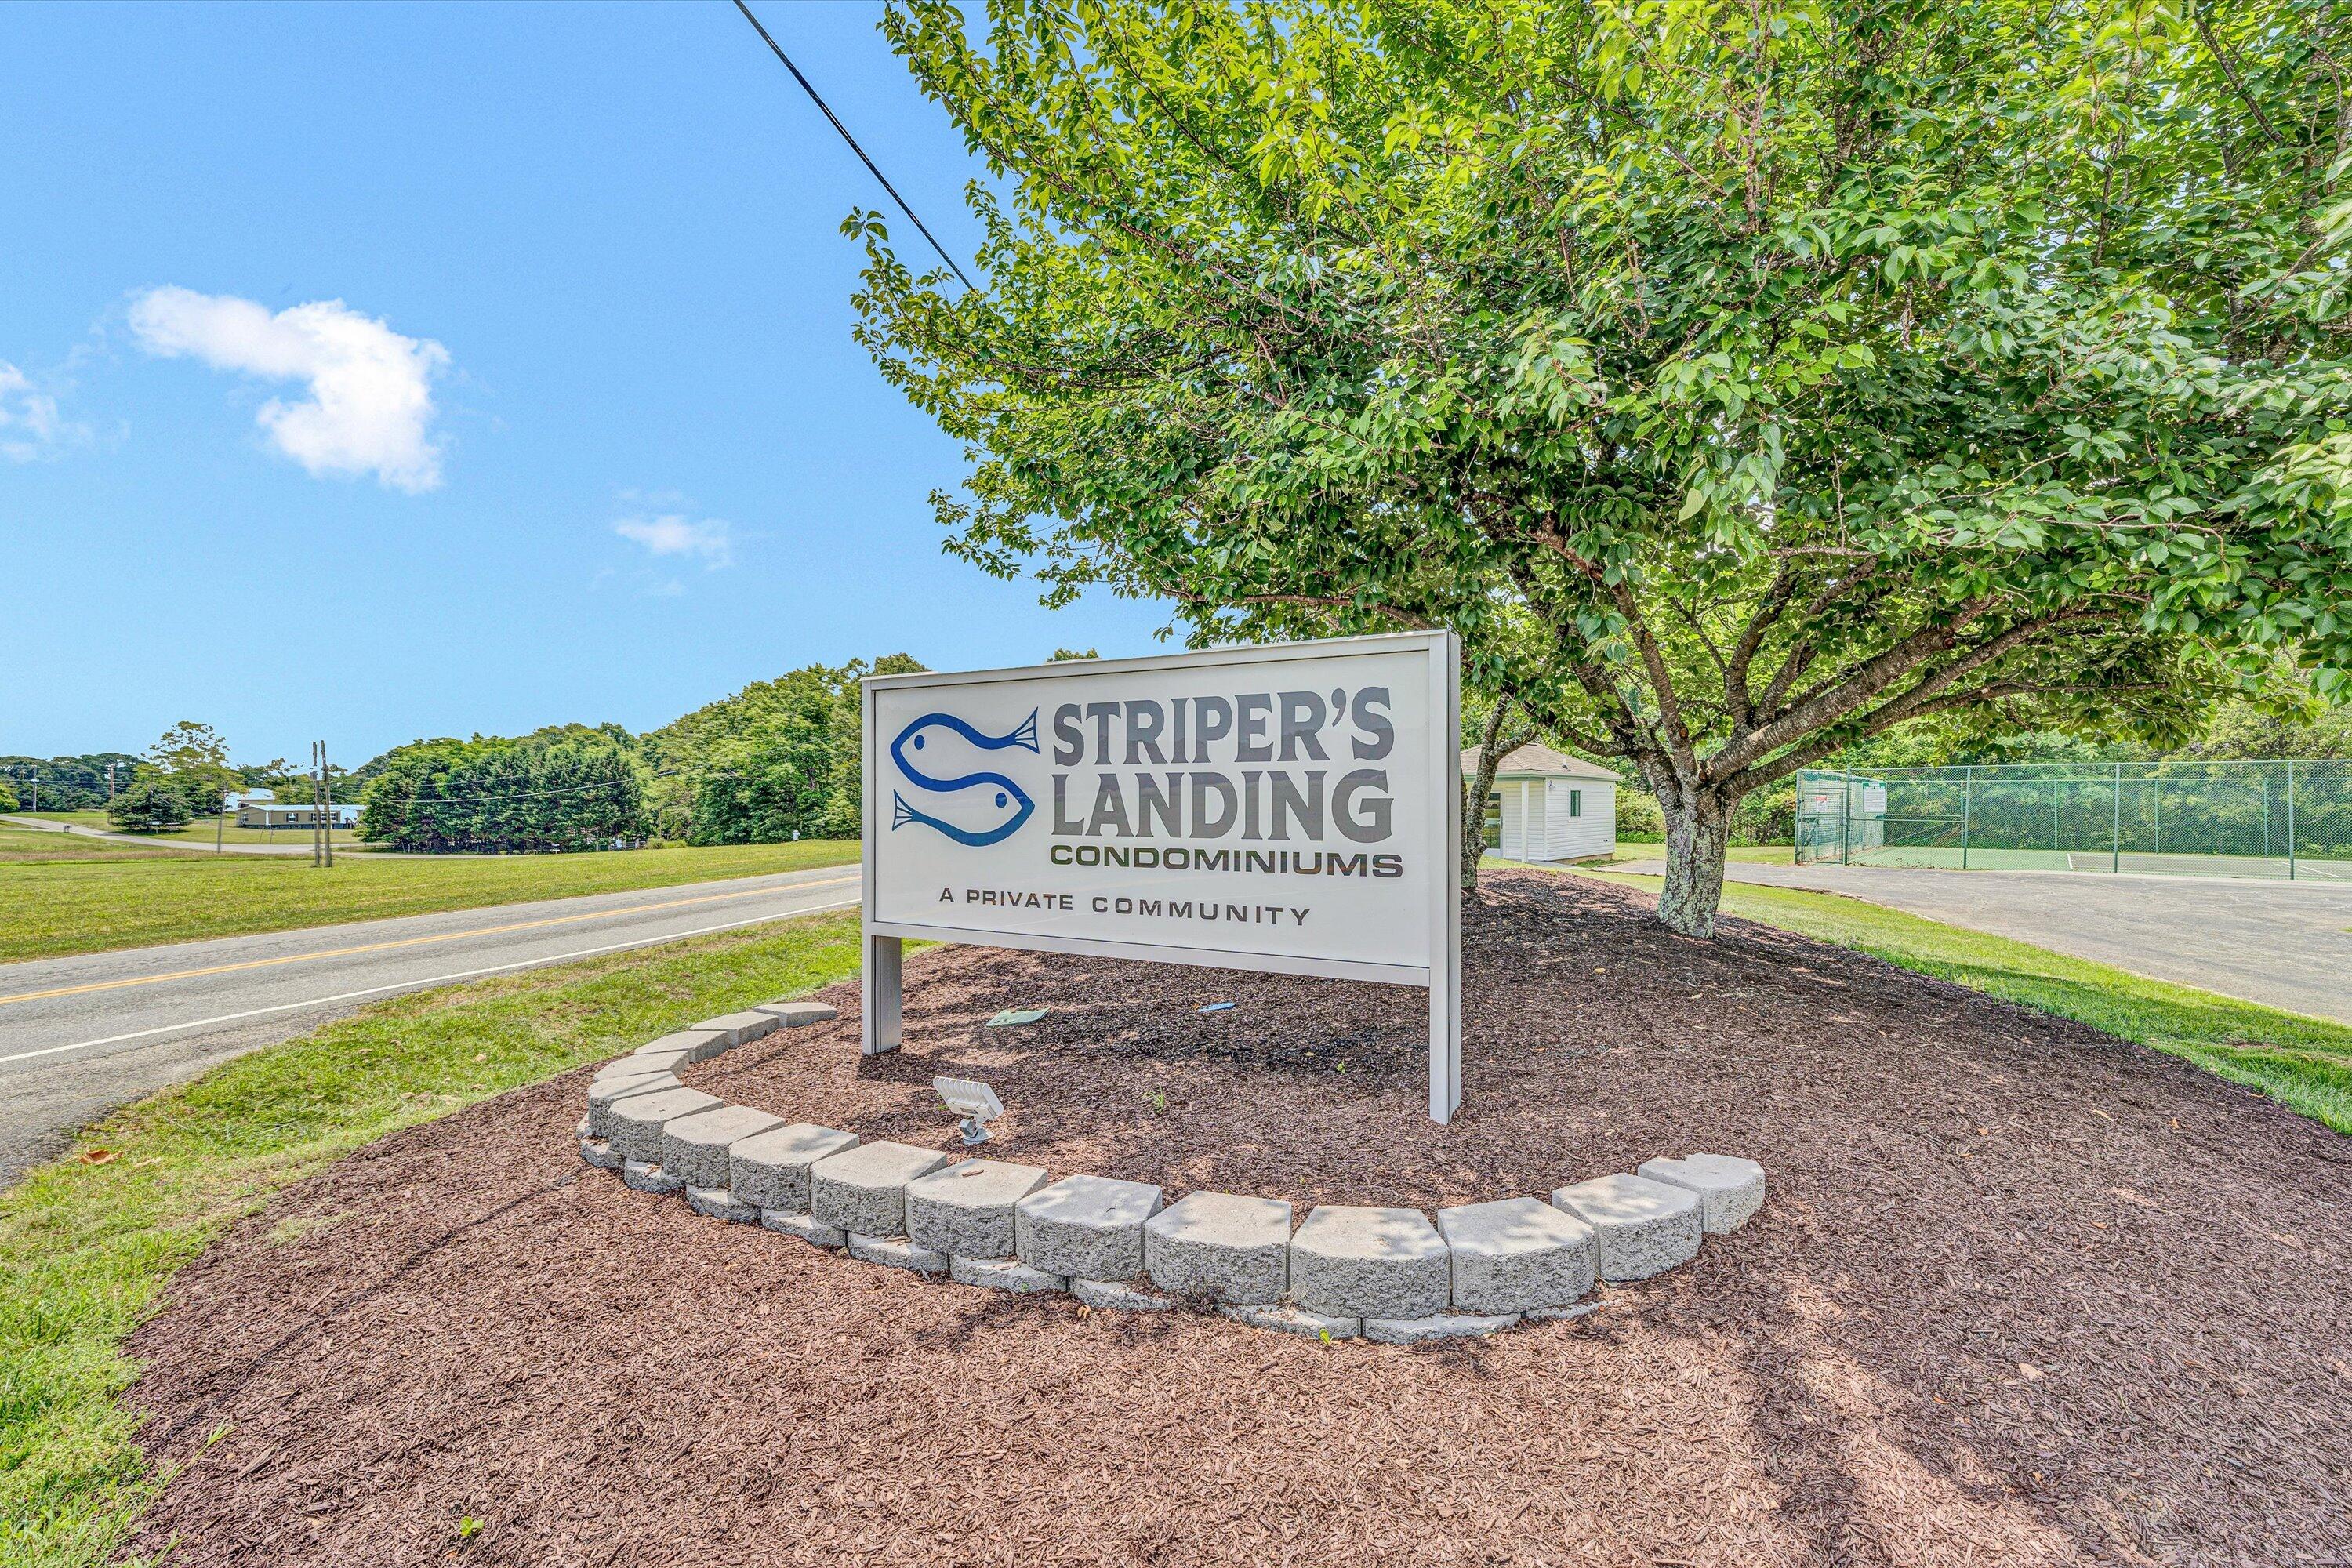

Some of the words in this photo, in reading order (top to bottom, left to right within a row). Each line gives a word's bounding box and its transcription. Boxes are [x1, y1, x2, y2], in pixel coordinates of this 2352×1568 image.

[1053, 687, 1394, 766] STRIPER’S
[1052, 769, 1394, 843] LANDING
[1051, 845, 1403, 878] CONDOMINIUMS
[940, 887, 954, 903] A
[967, 889, 1073, 910] PRIVATE
[1093, 897, 1311, 926] COMMUNITY
